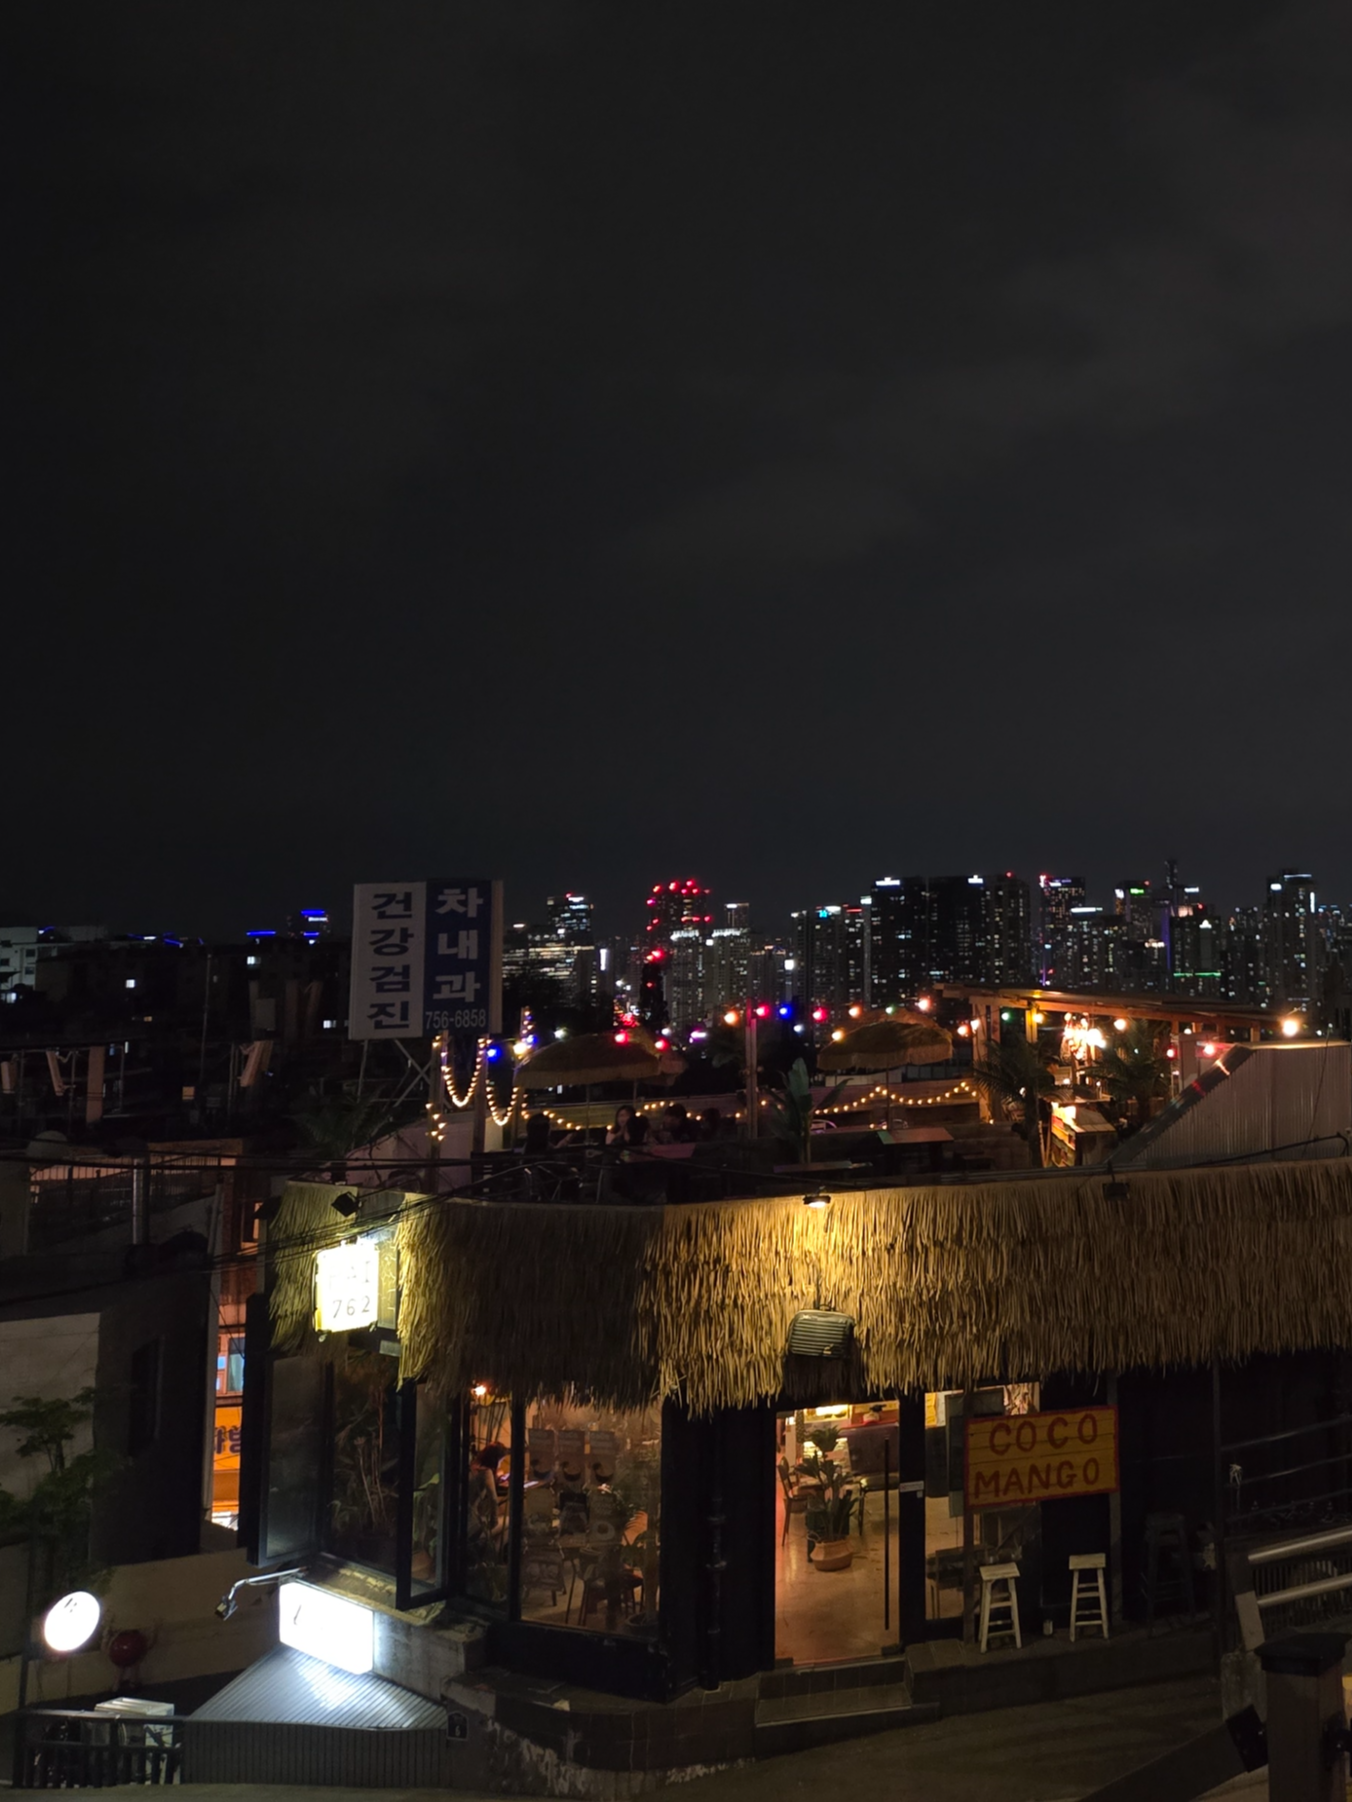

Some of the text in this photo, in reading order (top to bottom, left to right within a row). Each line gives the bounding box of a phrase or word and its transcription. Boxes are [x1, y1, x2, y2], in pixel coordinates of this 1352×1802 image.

[367, 892, 414, 1030] 건강검진
[433, 887, 484, 1003] 차내과
[425, 1009, 487, 1029] 756-6858
[332, 1295, 371, 1319] 762
[989, 1412, 1098, 1455] COCO
[974, 1457, 1101, 1499] MANGO
